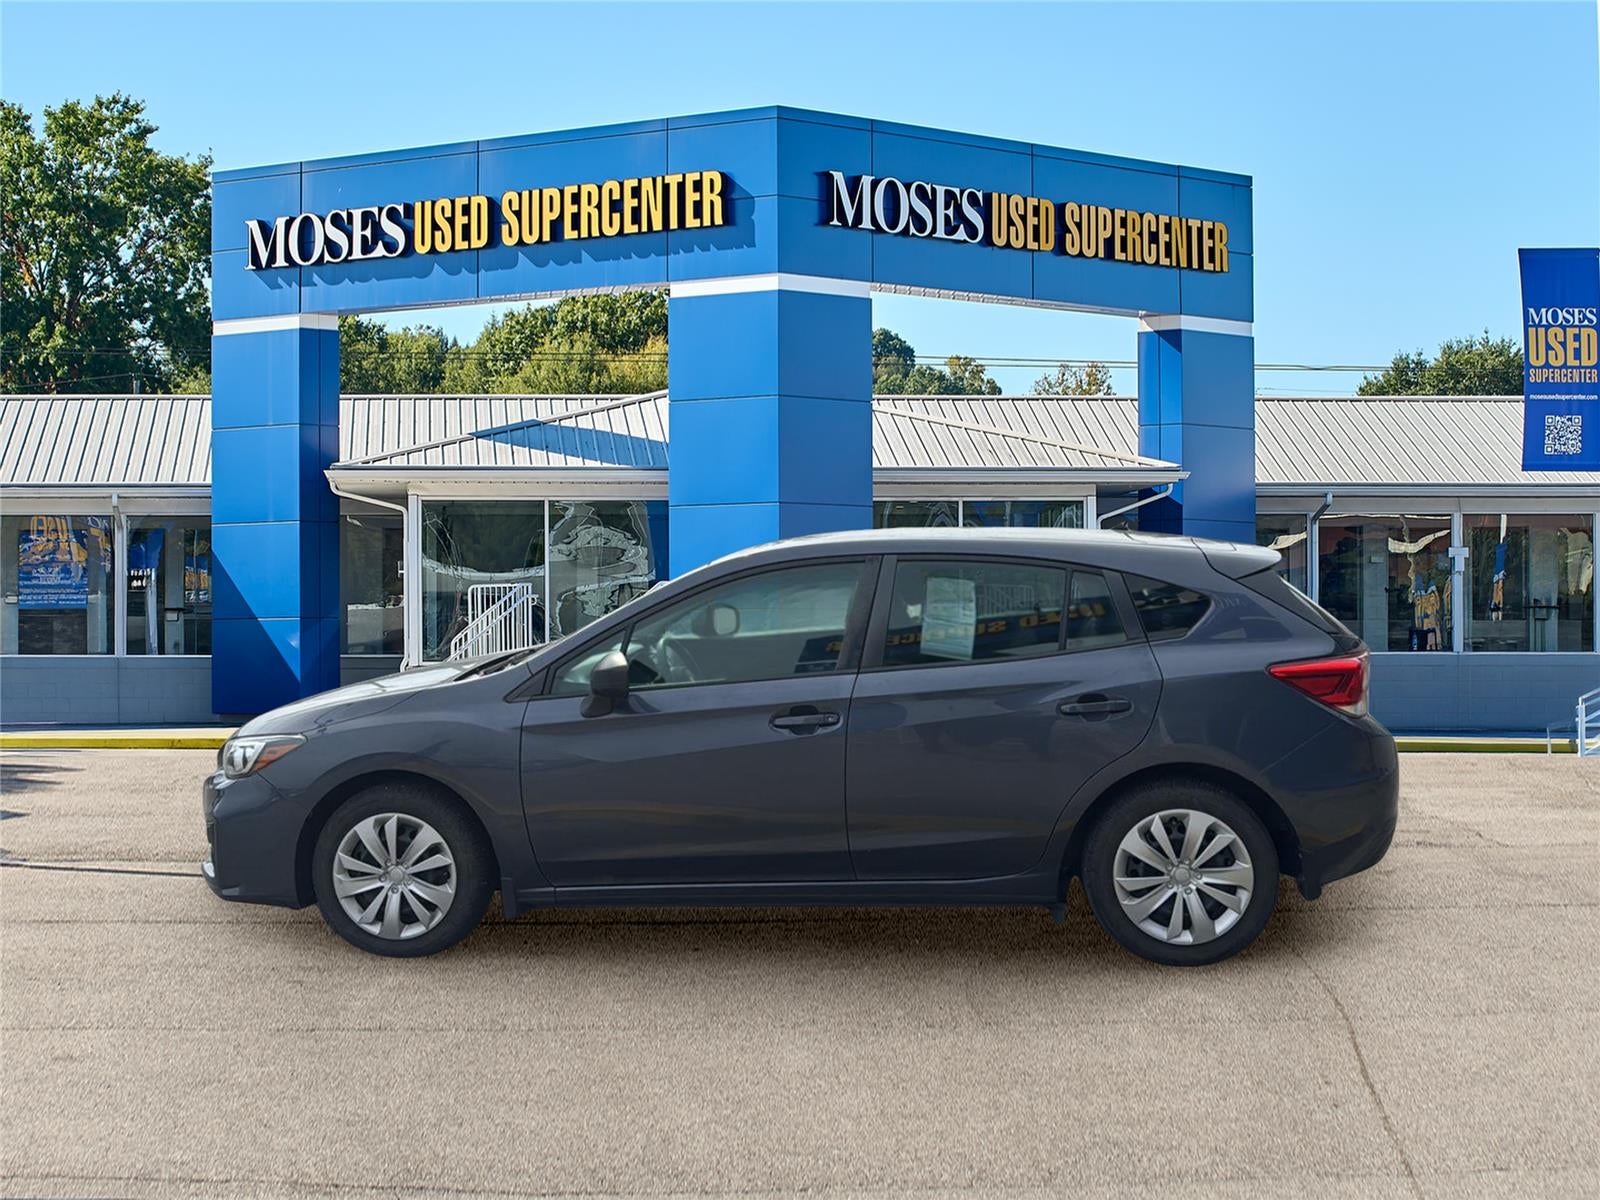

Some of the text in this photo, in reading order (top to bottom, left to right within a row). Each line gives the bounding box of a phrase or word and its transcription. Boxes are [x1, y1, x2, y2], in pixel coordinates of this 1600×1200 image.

[245, 171, 723, 271] MOSES USED SUPERCENTER
[829, 171, 1229, 273] MOSES USED SUPERCENTER
[1528, 307, 1597, 326] MOSES
[1528, 327, 1598, 366] USED
[1529, 368, 1598, 383] SUPERCENTER
